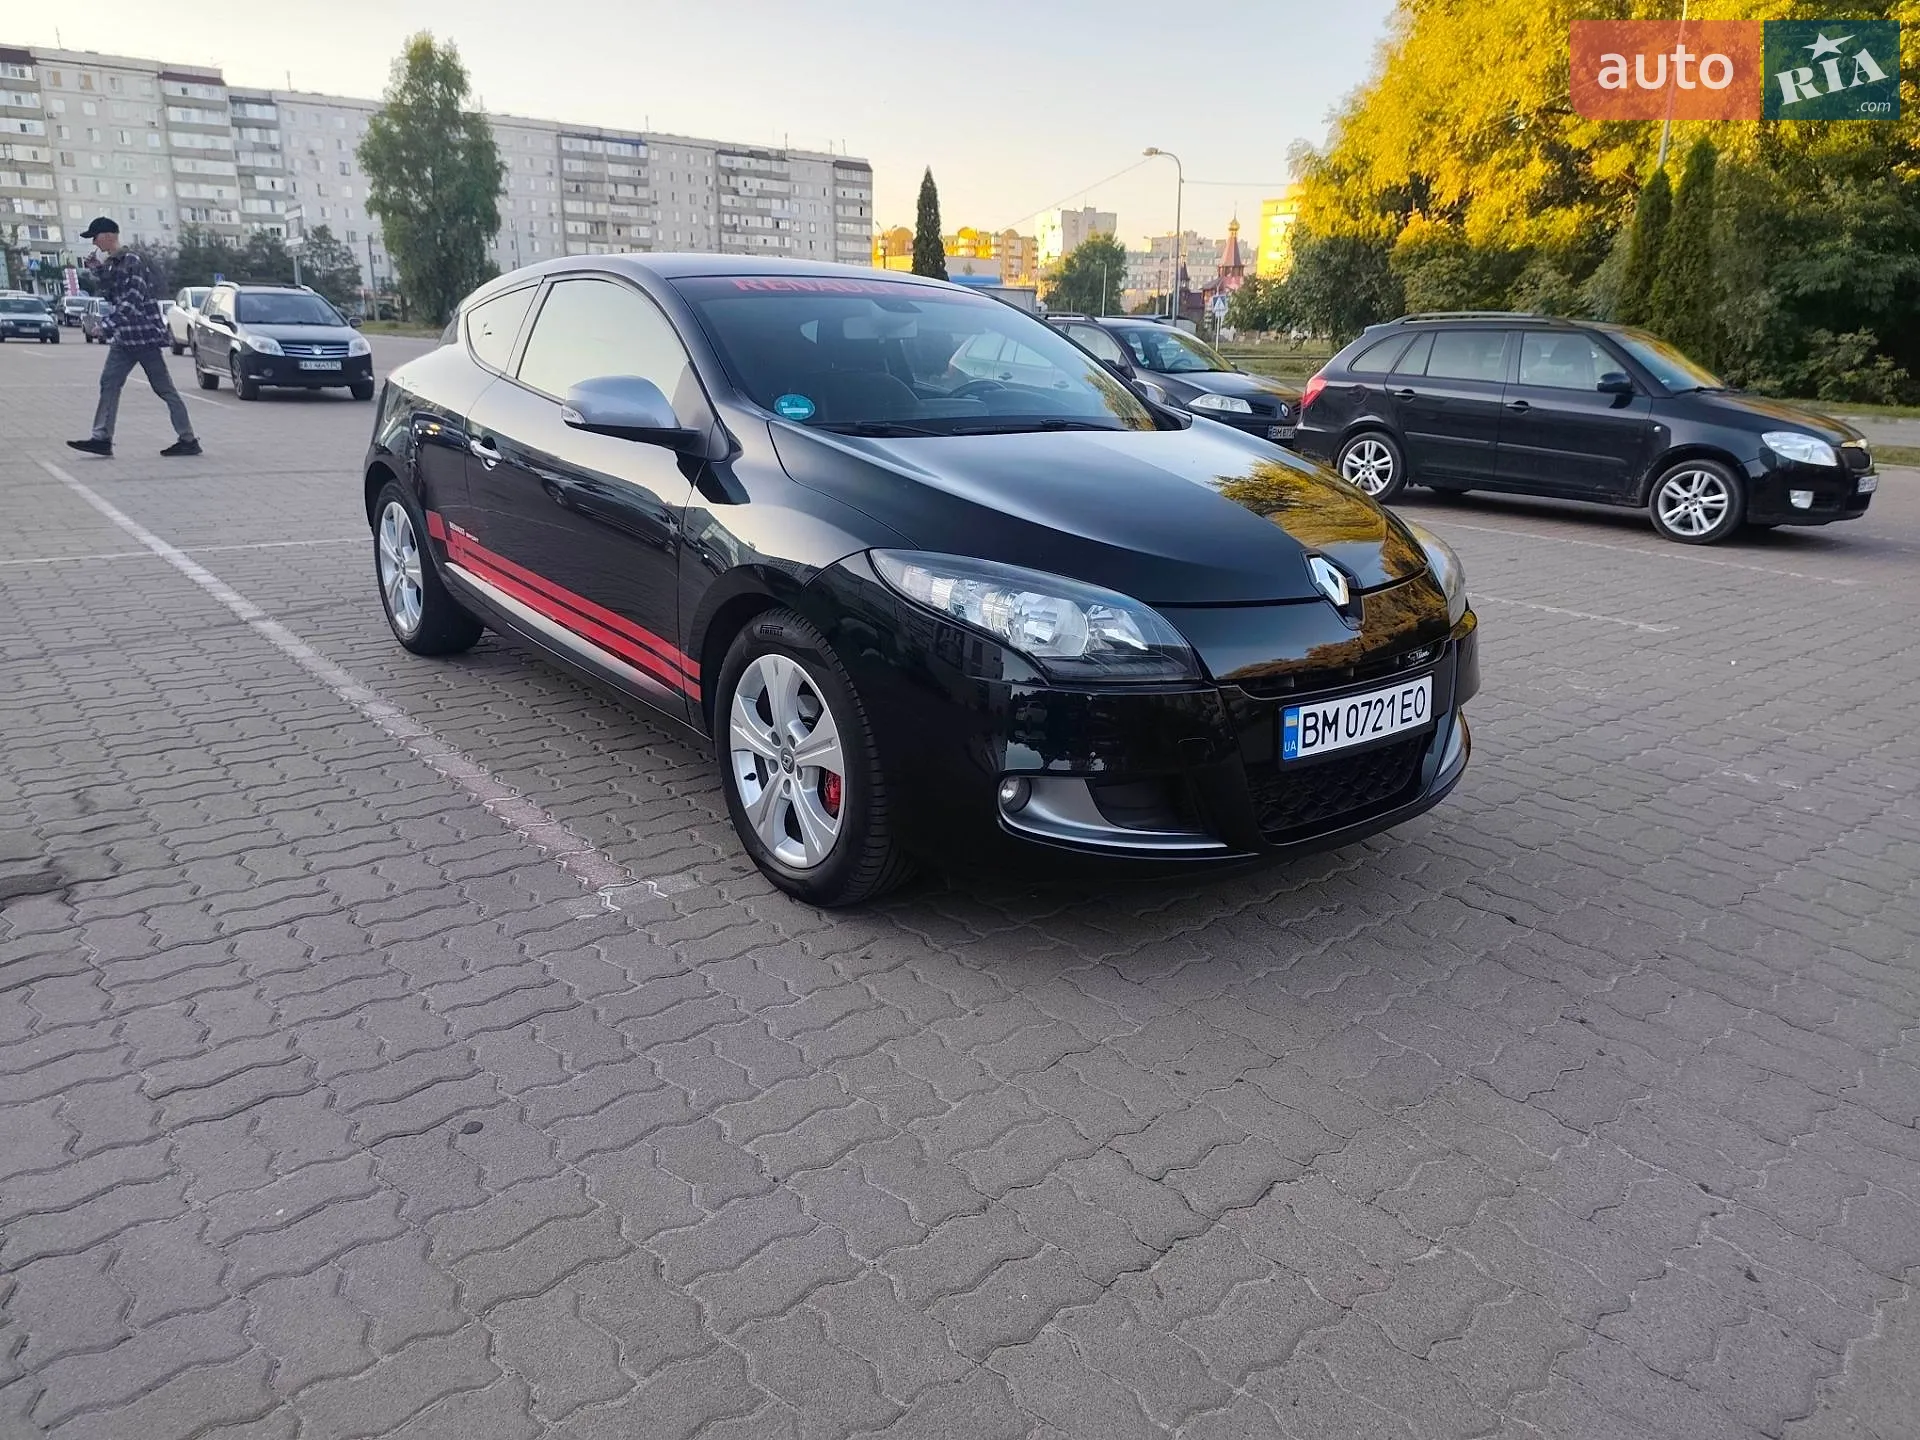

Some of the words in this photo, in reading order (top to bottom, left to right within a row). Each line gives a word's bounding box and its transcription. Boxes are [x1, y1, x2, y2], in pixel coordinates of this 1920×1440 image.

[732, 279, 893, 294] RENAULT
[1302, 707, 1340, 749] BM
[1345, 694, 1396, 739] 0721
[1400, 685, 1426, 725] EO
[1284, 740, 1297, 752] UA
